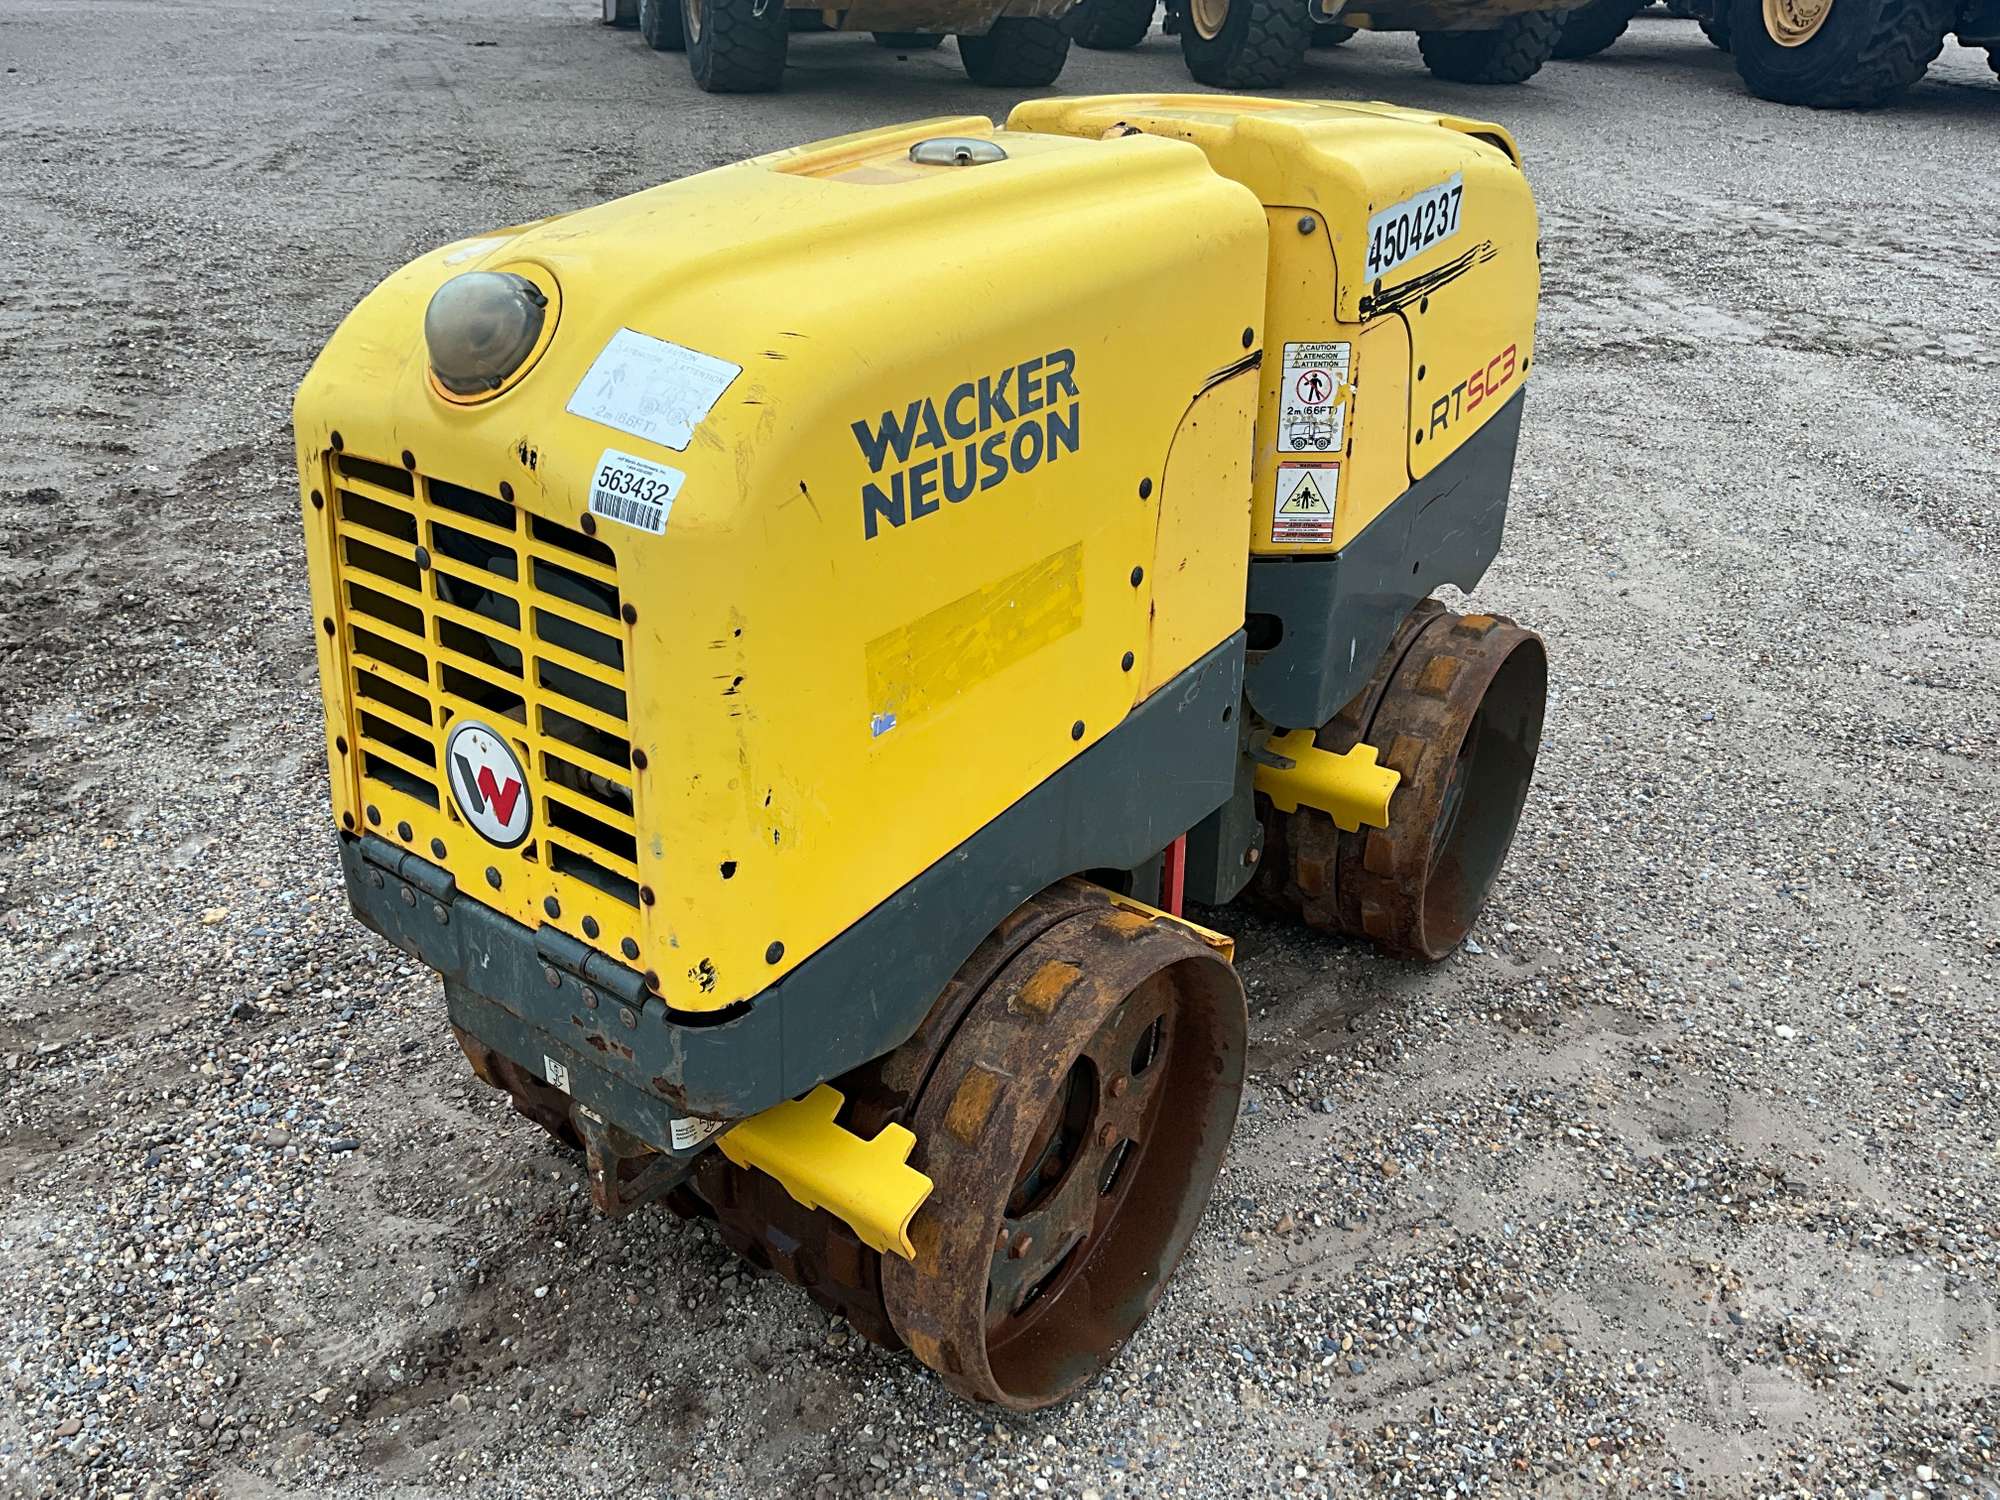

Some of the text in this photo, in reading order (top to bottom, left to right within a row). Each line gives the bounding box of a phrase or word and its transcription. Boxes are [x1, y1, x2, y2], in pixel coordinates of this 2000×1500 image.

[1368, 185, 1462, 273] 4504237
[1301, 360, 1339, 368] ATTENTION
[851, 348, 1080, 473] WACKER
[1287, 406, 1301, 415] 2m
[598, 465, 670, 506] 563432
[862, 402, 1080, 541] NEUSON
